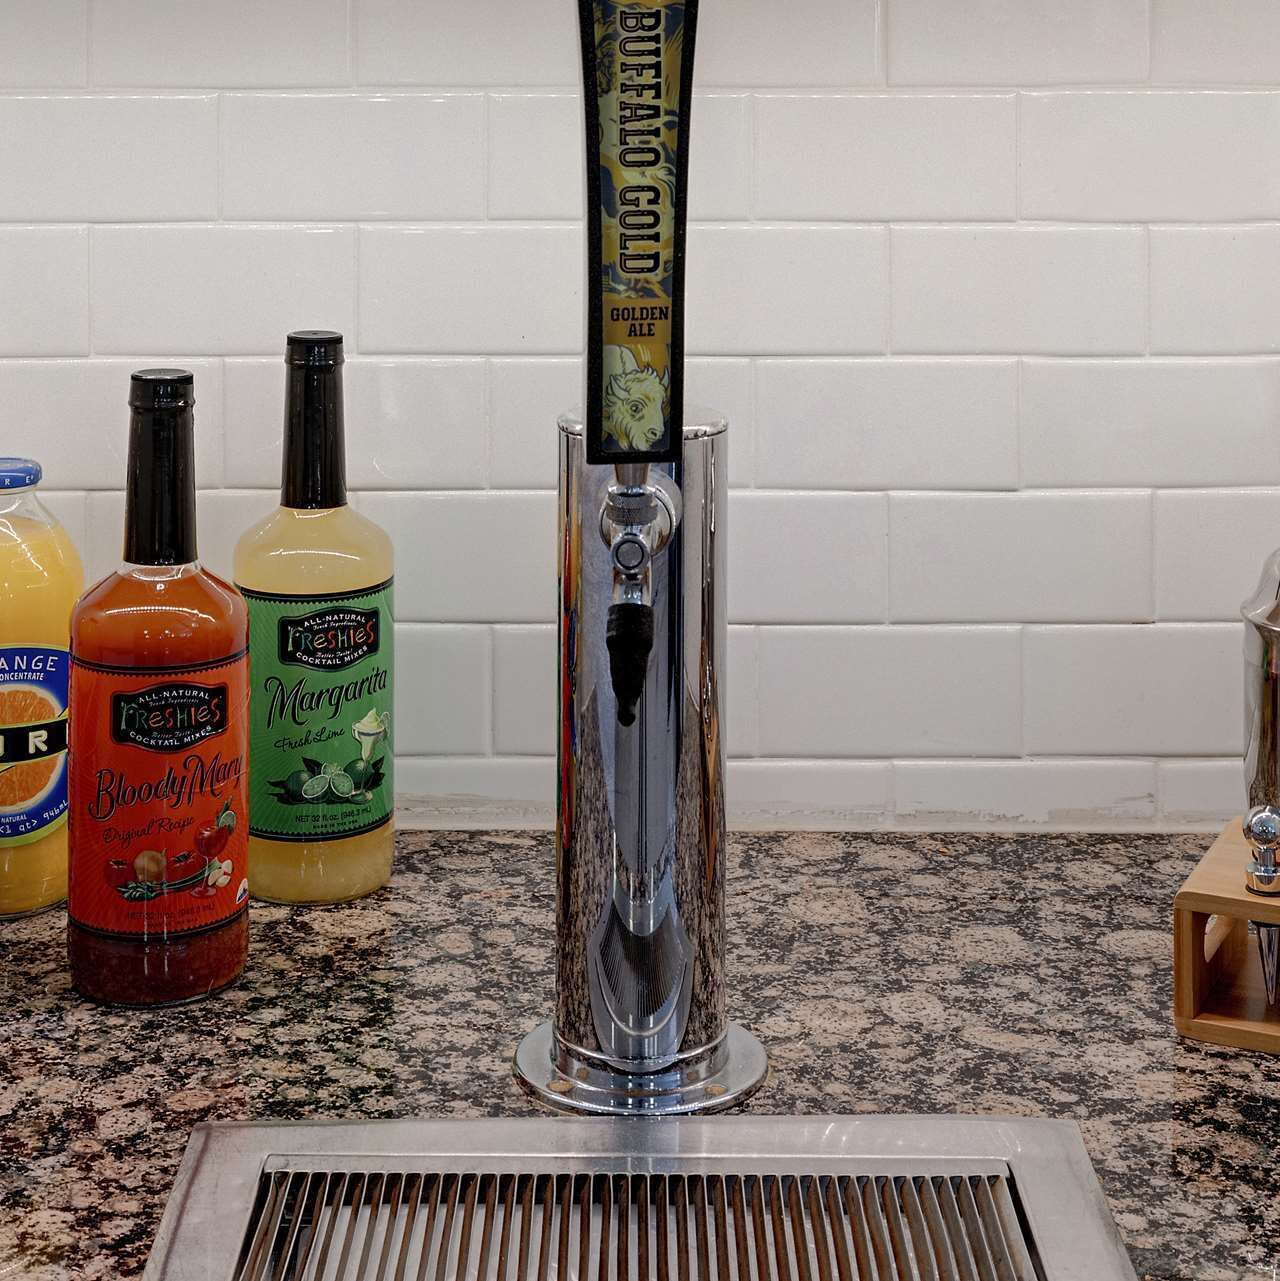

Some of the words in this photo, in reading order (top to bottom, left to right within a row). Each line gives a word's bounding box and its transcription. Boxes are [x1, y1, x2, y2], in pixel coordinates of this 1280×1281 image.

[618, 9, 663, 170] BUFFALO
[618, 184, 662, 275] GOLD
[610, 306, 670, 322] GOLDEN
[627, 322, 656, 338] ALE
[304, 613, 368, 629] ALL-NATURAL
[296, 651, 342, 665] COCKTAIL
[344, 645, 368, 663] MIXES
[316, 651, 334, 659] Better
[138, 688, 210, 704] ALL-NATURAL
[264, 668, 388, 730] Margarita
[129, 731, 180, 746] COCKTAIL
[184, 724, 214, 744] MIXES
[274, 731, 314, 753] Fresh
[313, 726, 346, 743] Lime
[88, 767, 188, 822] Bloody
[182, 752, 244, 807] Mary
[1, 814, 28, 824] NATURAL
[295, 814, 309, 823] NET
[103, 823, 153, 850] Original
[155, 814, 194, 838] Recipe
